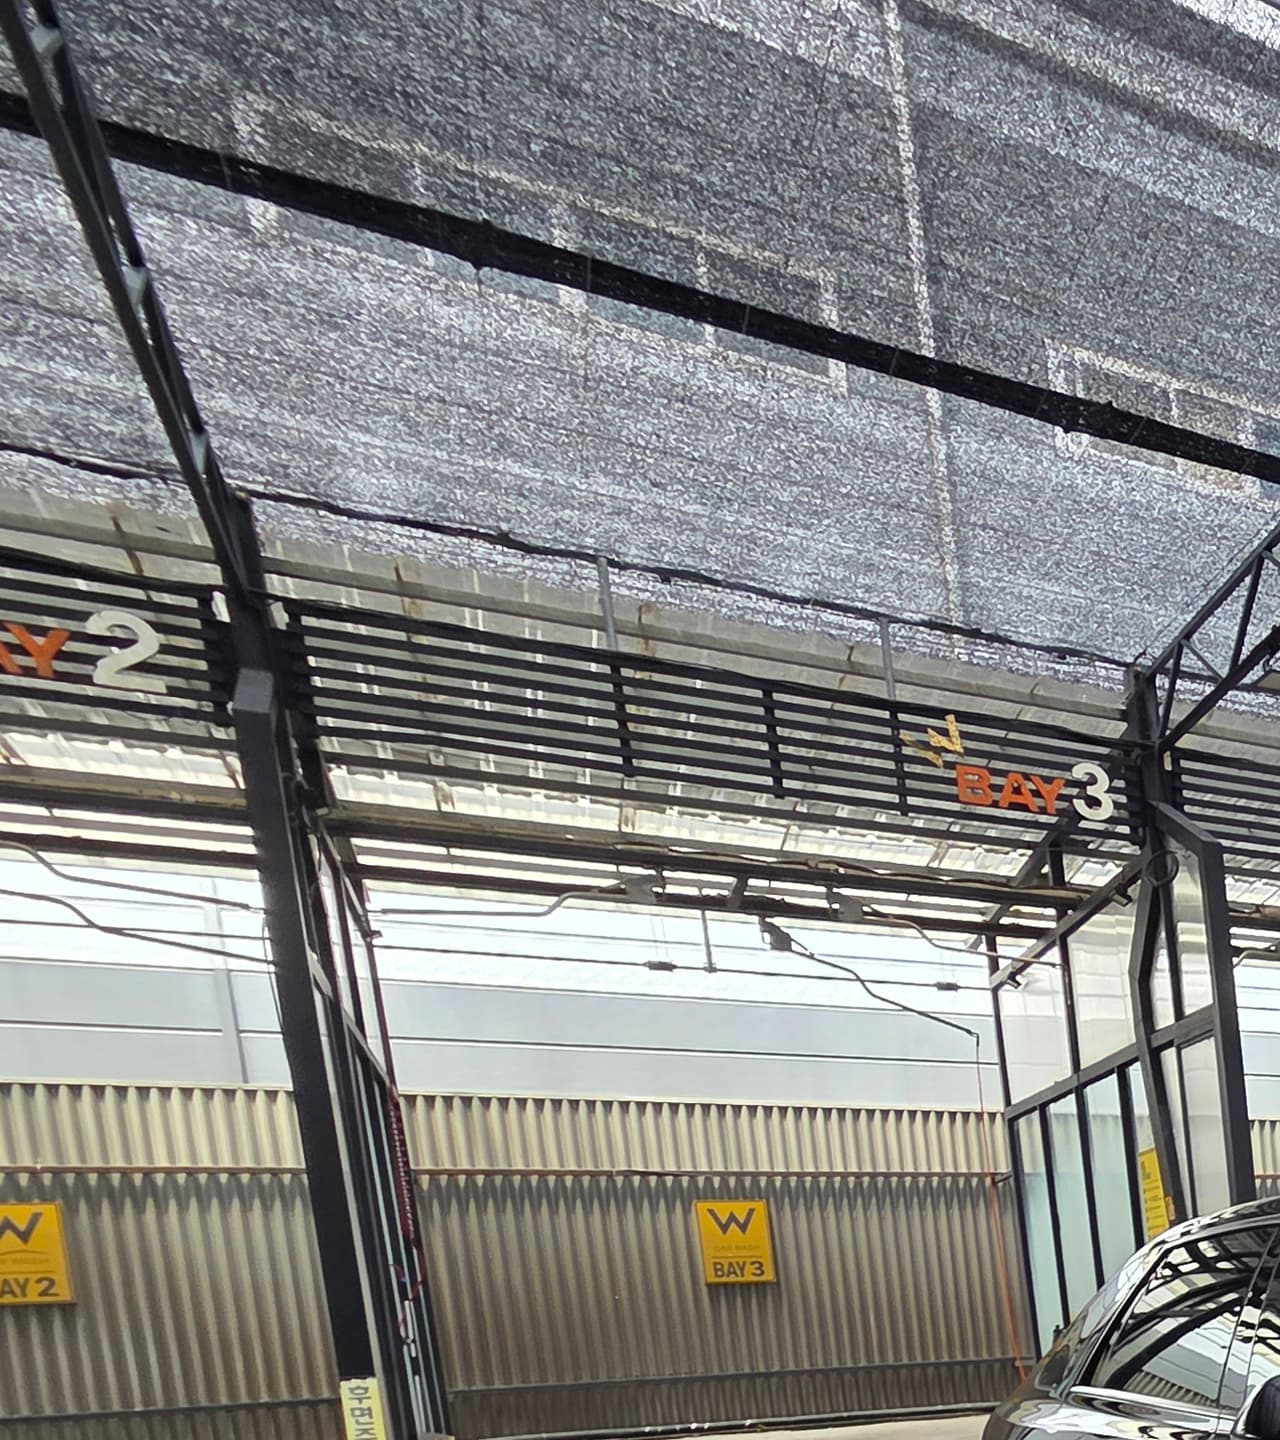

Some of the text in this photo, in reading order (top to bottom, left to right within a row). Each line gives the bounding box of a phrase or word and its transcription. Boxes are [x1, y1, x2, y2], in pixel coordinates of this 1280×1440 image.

[85, 610, 168, 694] 2
[955, 762, 1114, 821] BAY 3
[706, 1207, 756, 1236] W
[712, 1260, 765, 1278] BAY 3
[35, 1276, 60, 1297] 2
